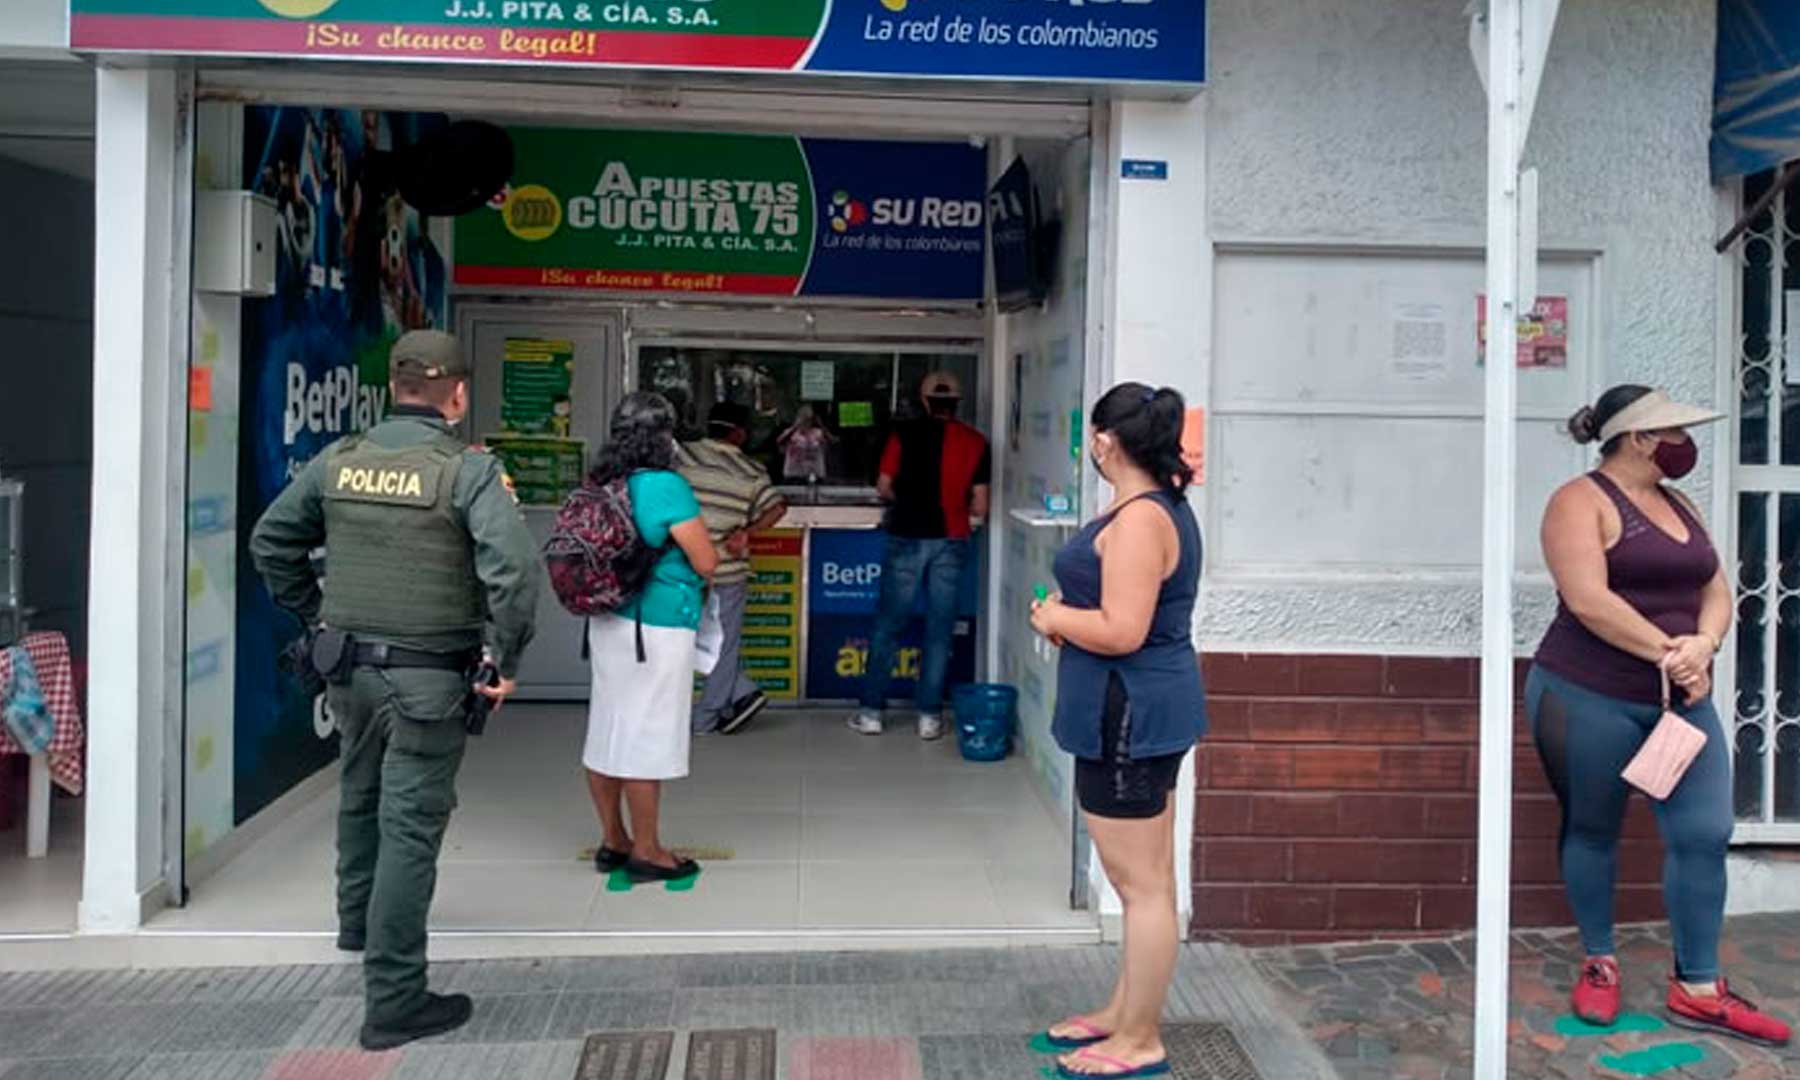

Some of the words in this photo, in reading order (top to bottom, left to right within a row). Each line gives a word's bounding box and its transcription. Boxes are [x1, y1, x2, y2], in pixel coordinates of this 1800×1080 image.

[445, 0, 493, 18] J.J.
[502, 1, 564, 21] PITA
[574, 3, 593, 21] &
[603, 1, 658, 24] CÍA.
[666, 7, 718, 26] S.A.
[378, 26, 485, 51] chance
[500, 28, 597, 56] legal!
[864, 14, 892, 40] La
[898, 15, 940, 43] red
[944, 16, 972, 44] de
[978, 17, 1011, 45] los
[1017, 19, 1158, 49] colombianos
[593, 161, 799, 204] APUESTAS
[567, 192, 741, 234] CÚCUTA
[751, 203, 799, 236] 75
[615, 234, 648, 246] J.J.
[654, 235, 696, 249] PITA
[702, 236, 716, 249] &
[764, 239, 799, 252] S.A.
[586, 270, 653, 288] chance
[284, 362, 386, 445] BetPlay
[337, 466, 422, 497] POLICIA
[822, 562, 882, 586] BetP
